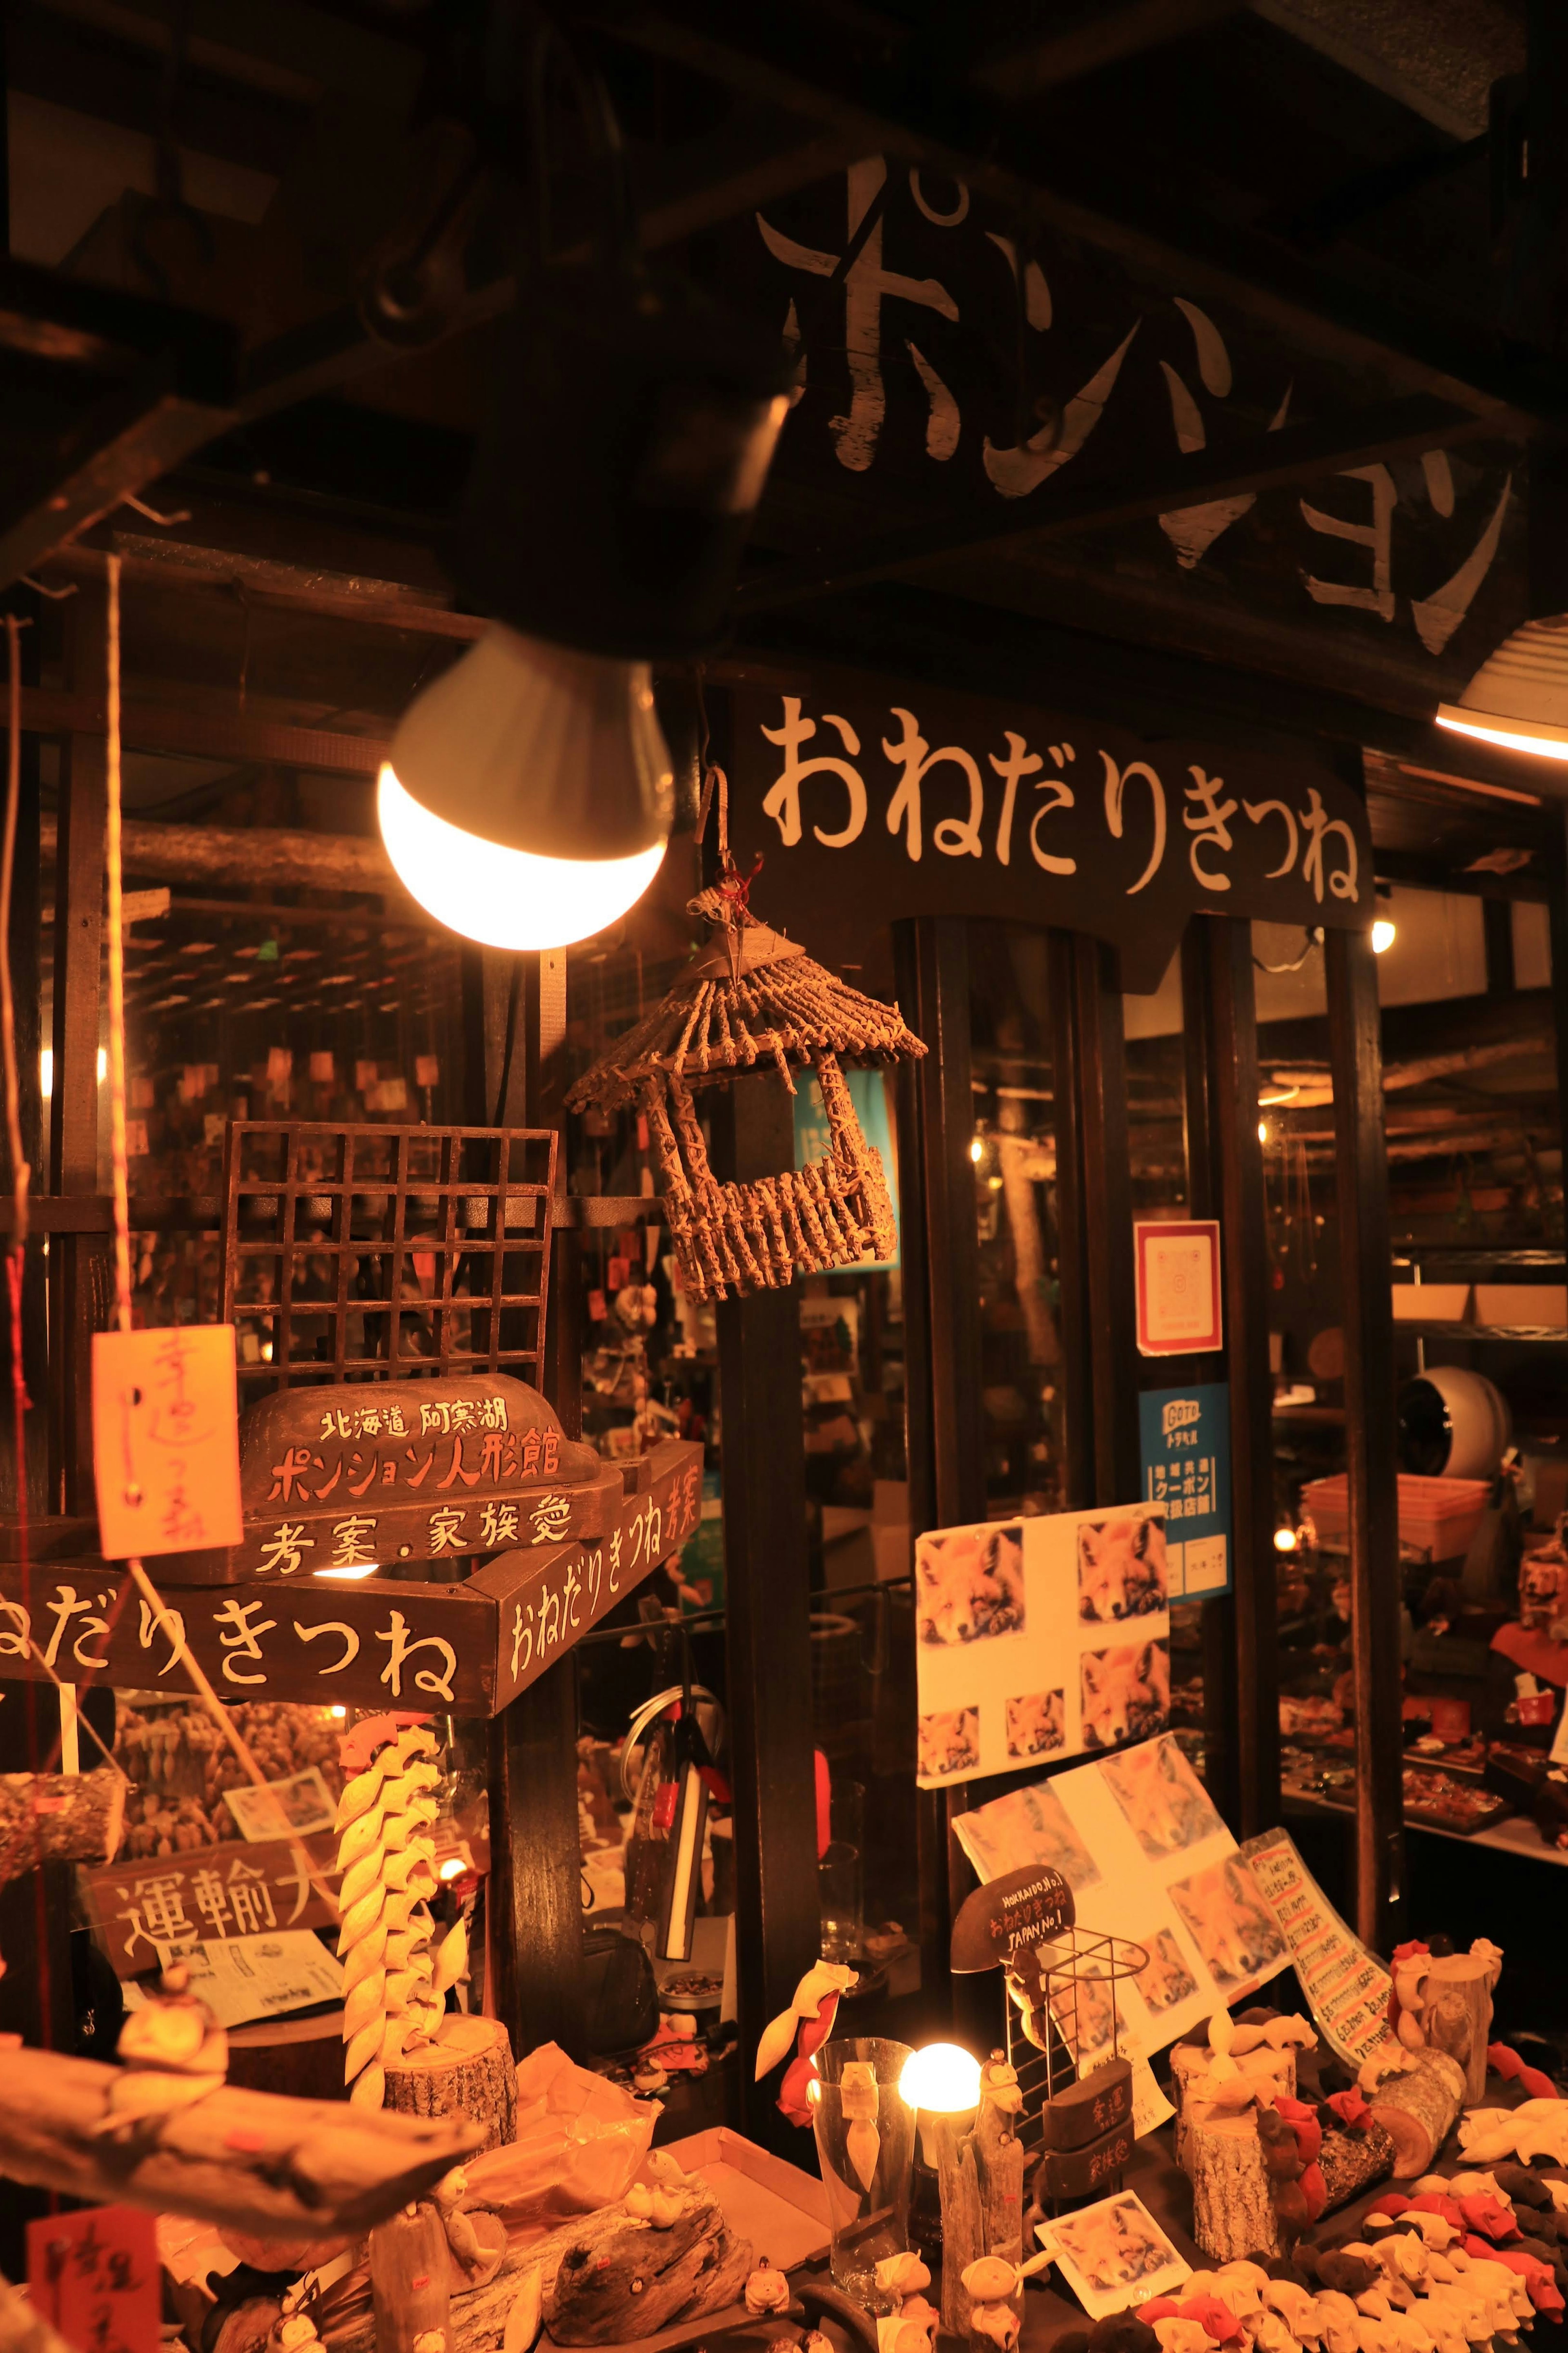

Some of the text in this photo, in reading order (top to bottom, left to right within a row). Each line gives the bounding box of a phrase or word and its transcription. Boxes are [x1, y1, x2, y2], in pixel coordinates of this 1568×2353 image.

[760, 696, 1359, 903] おねだりきつね
[319, 1396, 508, 1441] 北海道 阿寒湖
[1166, 1430, 1198, 1449] トラベル
[266, 1426, 561, 1502] ポンション人形館
[1155, 1475, 1209, 1500] クーポン
[510, 1495, 661, 1683] おねだりきつね
